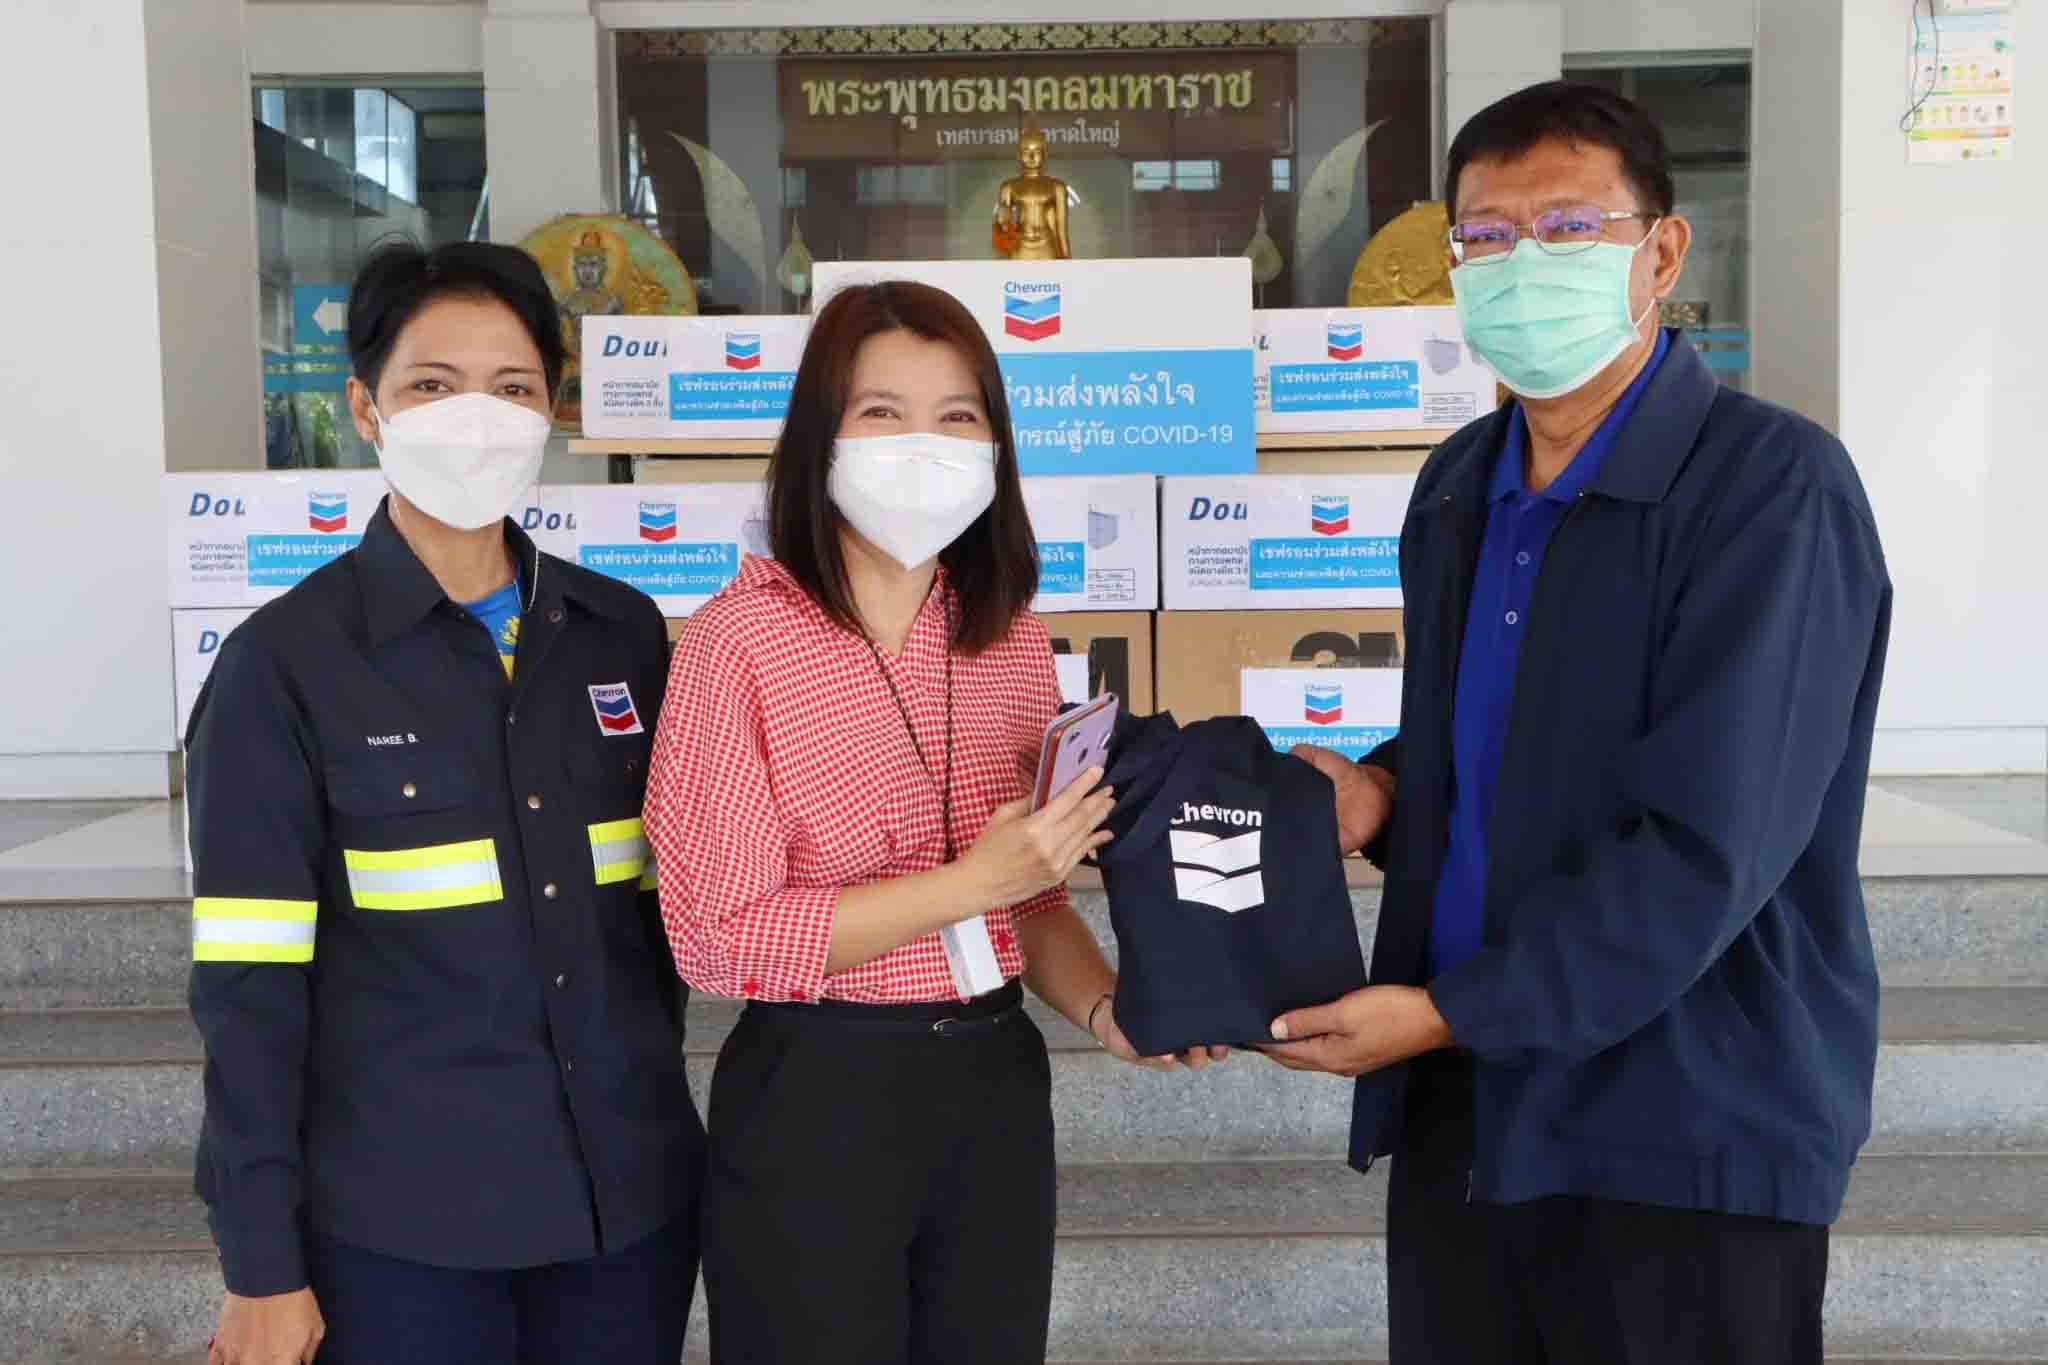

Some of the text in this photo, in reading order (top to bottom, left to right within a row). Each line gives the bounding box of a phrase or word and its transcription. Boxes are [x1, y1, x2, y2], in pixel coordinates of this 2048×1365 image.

[802, 70, 1253, 128] พระพุทธมงคลมหาราช
[936, 118, 1120, 147] เทศบาลนหาดใหญ่
[1004, 281, 1061, 293] Chevron
[602, 335, 667, 357] Dou
[1124, 425, 1233, 445] COVID-19
[367, 735, 405, 746] NAREE
